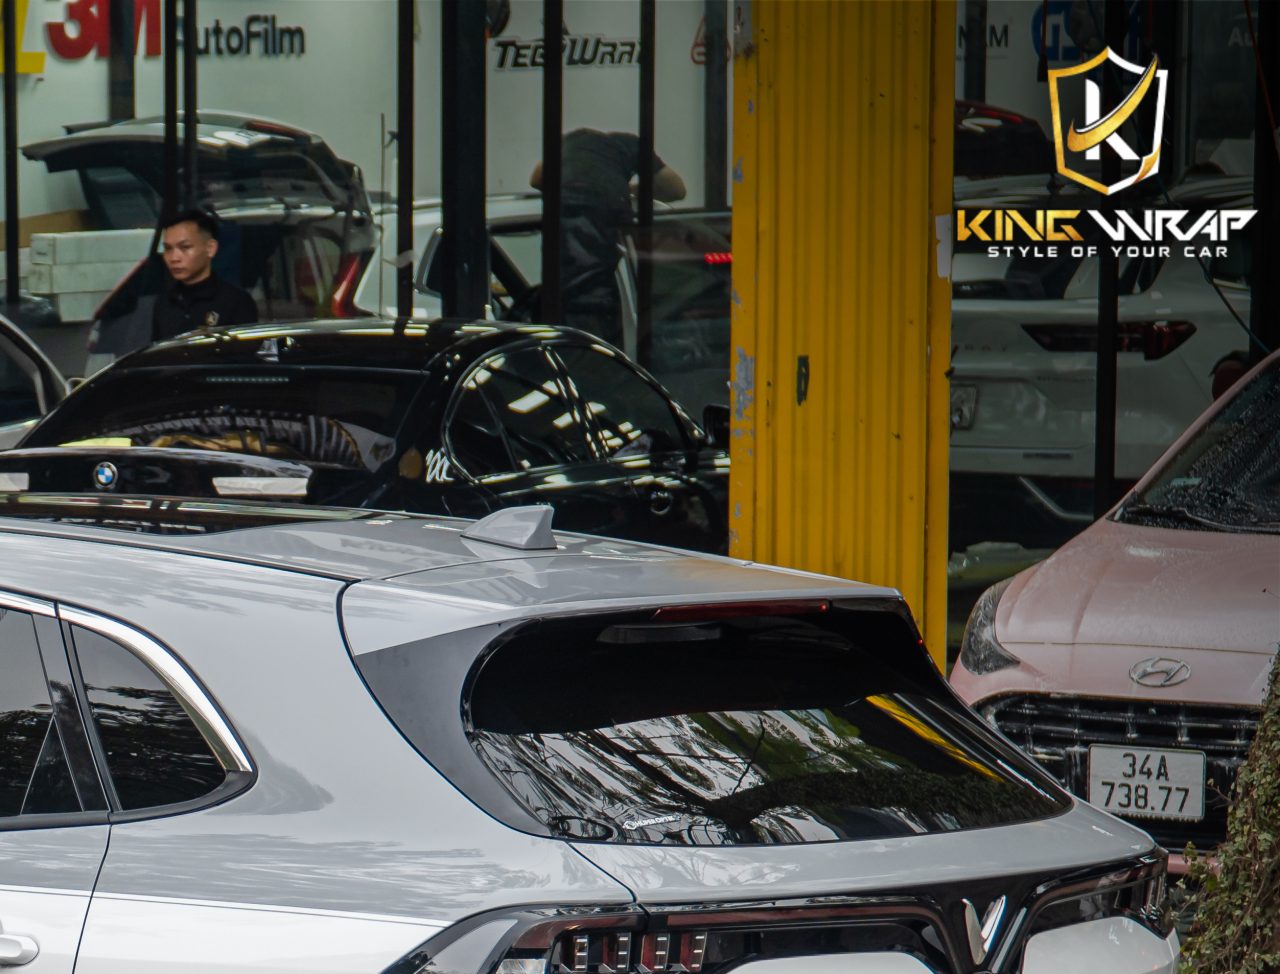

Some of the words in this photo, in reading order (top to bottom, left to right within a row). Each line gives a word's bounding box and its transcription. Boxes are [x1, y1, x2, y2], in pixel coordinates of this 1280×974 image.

[176, 14, 306, 56] utoFilm
[1122, 752, 1170, 781] 34A
[1101, 781, 1191, 813] 738.77
